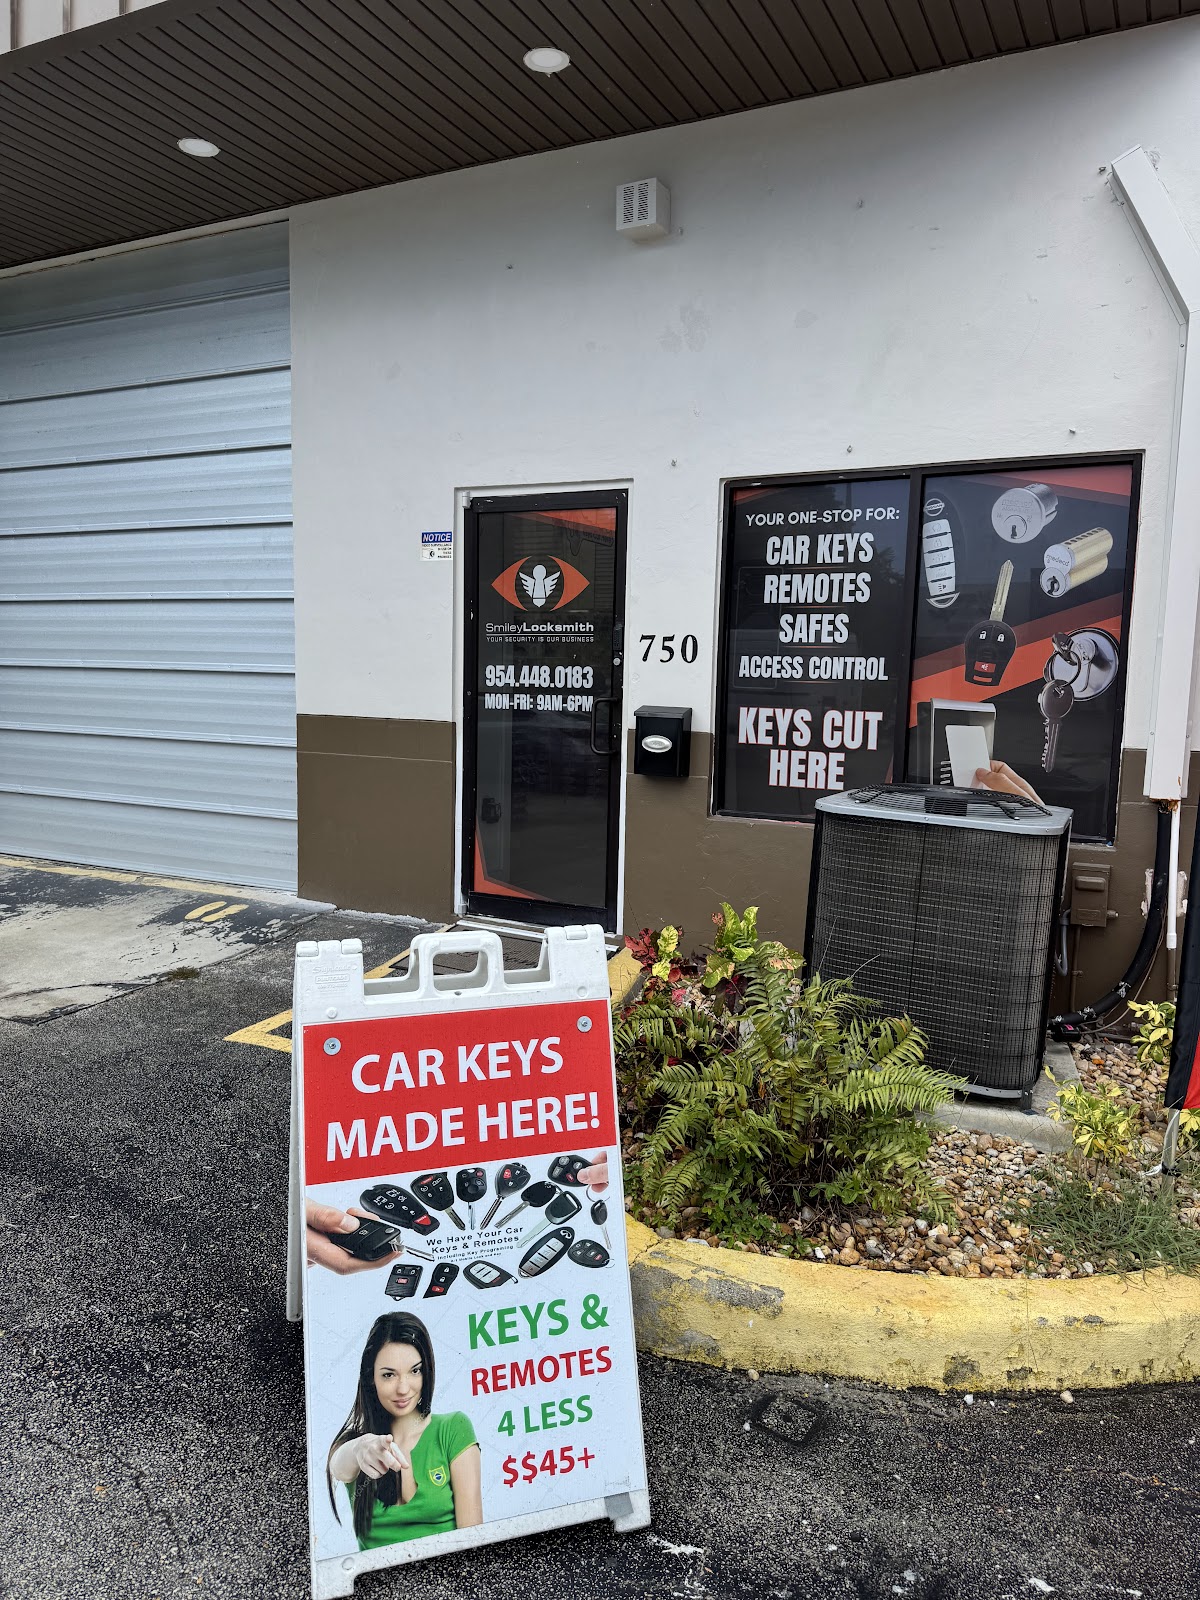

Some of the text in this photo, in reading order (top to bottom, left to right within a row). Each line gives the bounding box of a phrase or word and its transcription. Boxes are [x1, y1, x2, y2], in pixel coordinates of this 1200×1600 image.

[746, 507, 900, 527] YOUR ONE-STOP FOR:
[423, 533, 451, 542] NOTICE
[766, 532, 874, 566] CAR KEYS
[763, 572, 871, 604] REMOTES
[485, 622, 594, 633] SmileyLocksmith
[779, 613, 849, 644] SAFES
[639, 634, 699, 663] 750
[485, 664, 594, 689] 954.448.0183
[738, 655, 888, 681] ACCESS CONTROL
[484, 693, 594, 712] MON-FRI: 9AM-6PM
[738, 706, 884, 751] KEYS CUT
[768, 749, 846, 791] HERE
[351, 1036, 564, 1094] CAR KEYS
[326, 1091, 601, 1163] MADE HERE!
[432, 1246, 458, 1254] Keys
[474, 1236, 519, 1247] Remotes
[447, 1234, 472, 1243] Have
[477, 1230, 502, 1239] Your
[437, 1251, 465, 1260] Including
[468, 1293, 610, 1350] KEYS &
[471, 1345, 613, 1396] REMOTES
[497, 1395, 593, 1437] 4 LESS
[502, 1445, 596, 1489] $$45+
